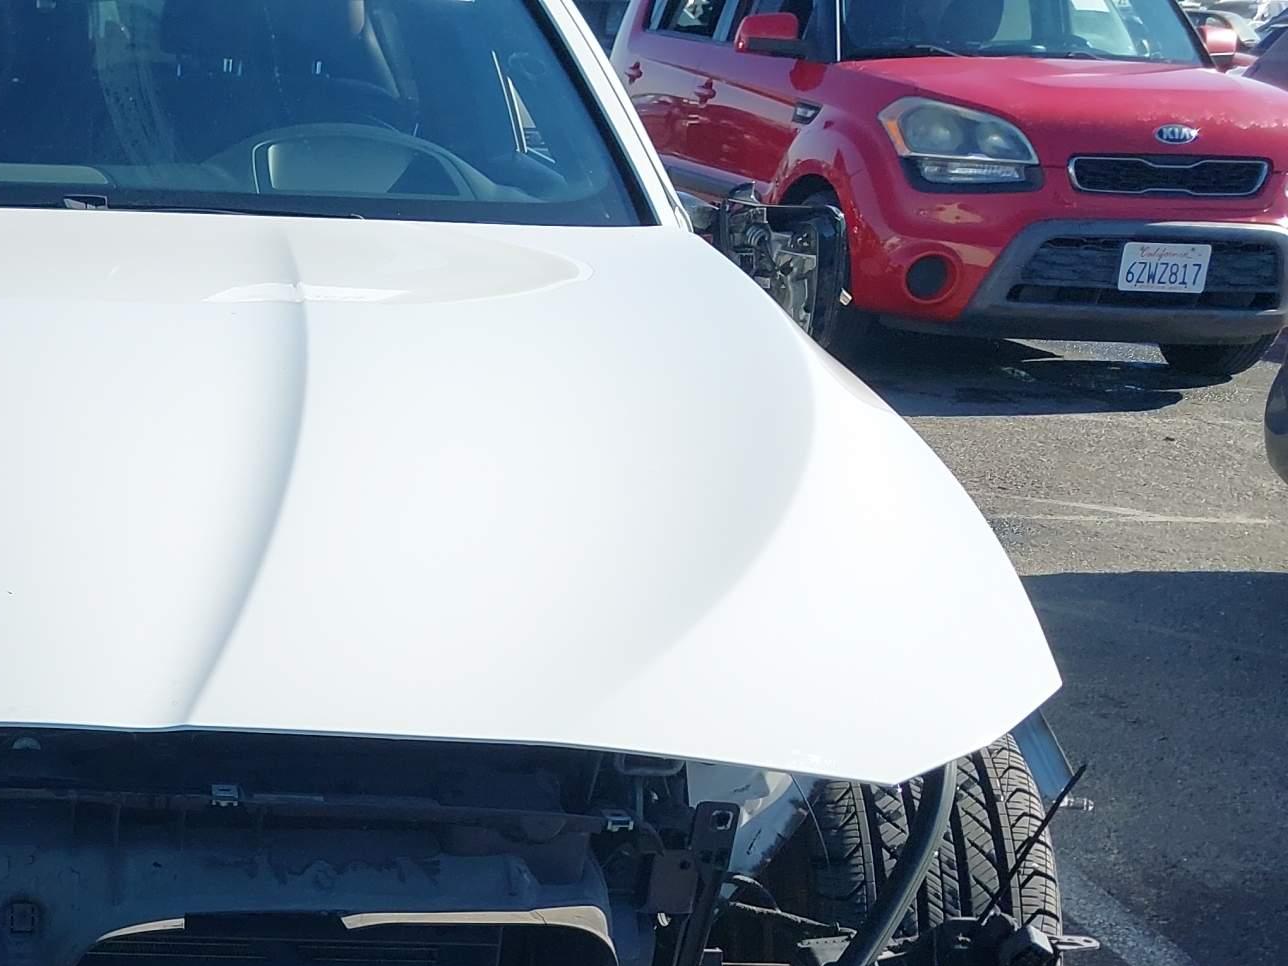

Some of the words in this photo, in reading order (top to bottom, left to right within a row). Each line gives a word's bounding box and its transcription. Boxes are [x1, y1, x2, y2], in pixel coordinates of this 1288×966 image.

[1162, 127, 1191, 140] KIA
[1138, 246, 1192, 260] California
[1125, 261, 1202, 286] 6ZWZ817
